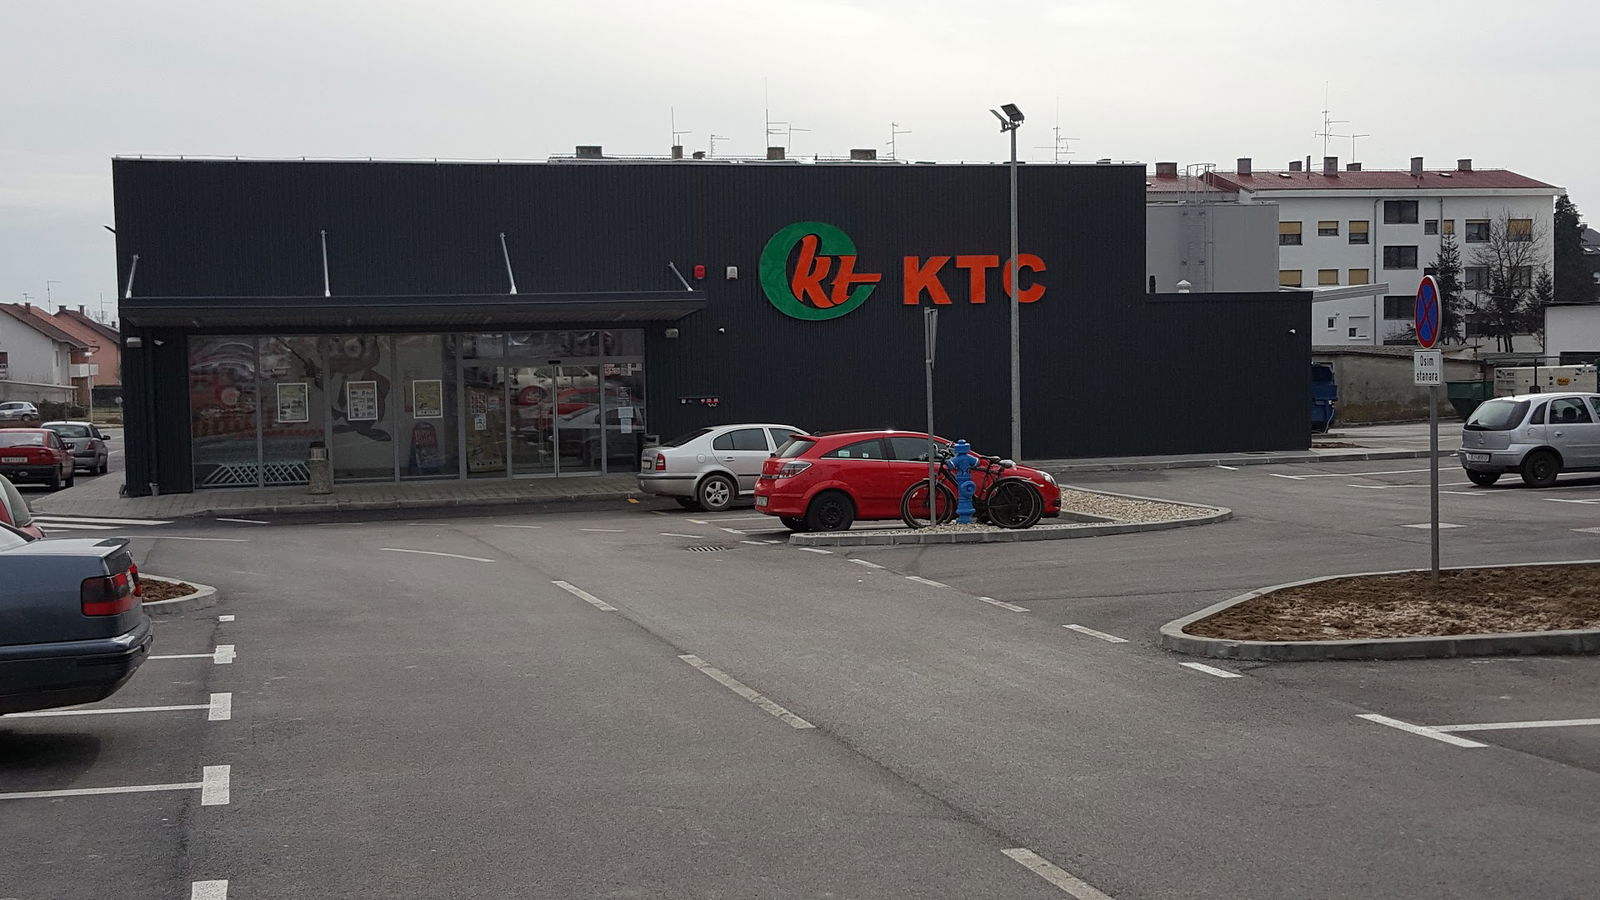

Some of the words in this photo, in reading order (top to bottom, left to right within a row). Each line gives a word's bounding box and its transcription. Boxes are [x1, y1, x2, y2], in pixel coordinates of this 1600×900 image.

[903, 253, 1047, 305] KTC
[1420, 354, 1435, 367] Osim
[1416, 370, 1439, 381] stanara
